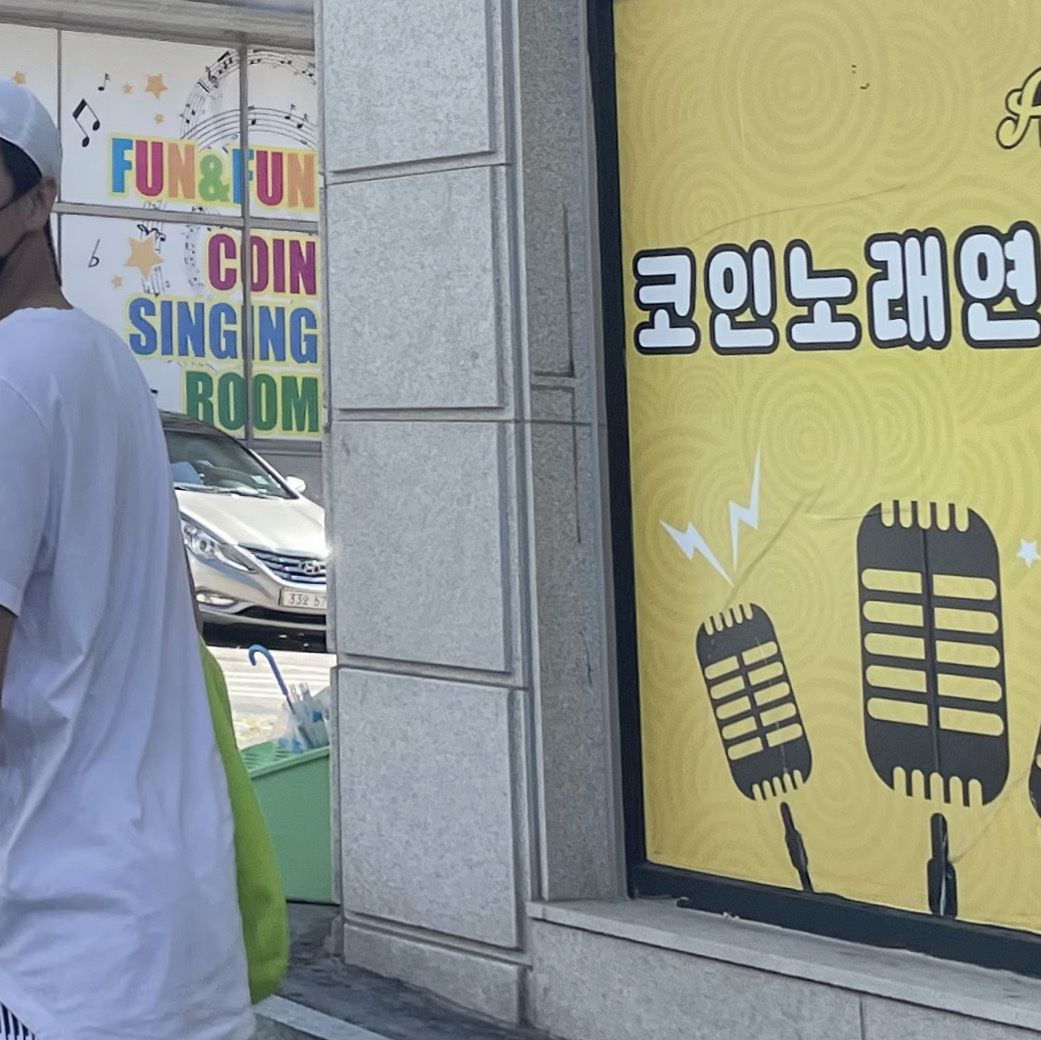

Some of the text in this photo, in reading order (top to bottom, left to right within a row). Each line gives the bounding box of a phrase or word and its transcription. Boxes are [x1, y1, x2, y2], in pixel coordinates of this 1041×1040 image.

[111, 137, 316, 209] FUN&FUN
[207, 232, 318, 296] COIN
[632, 219, 1041, 356] 코인노래연
[185, 370, 320, 433] ROOM
